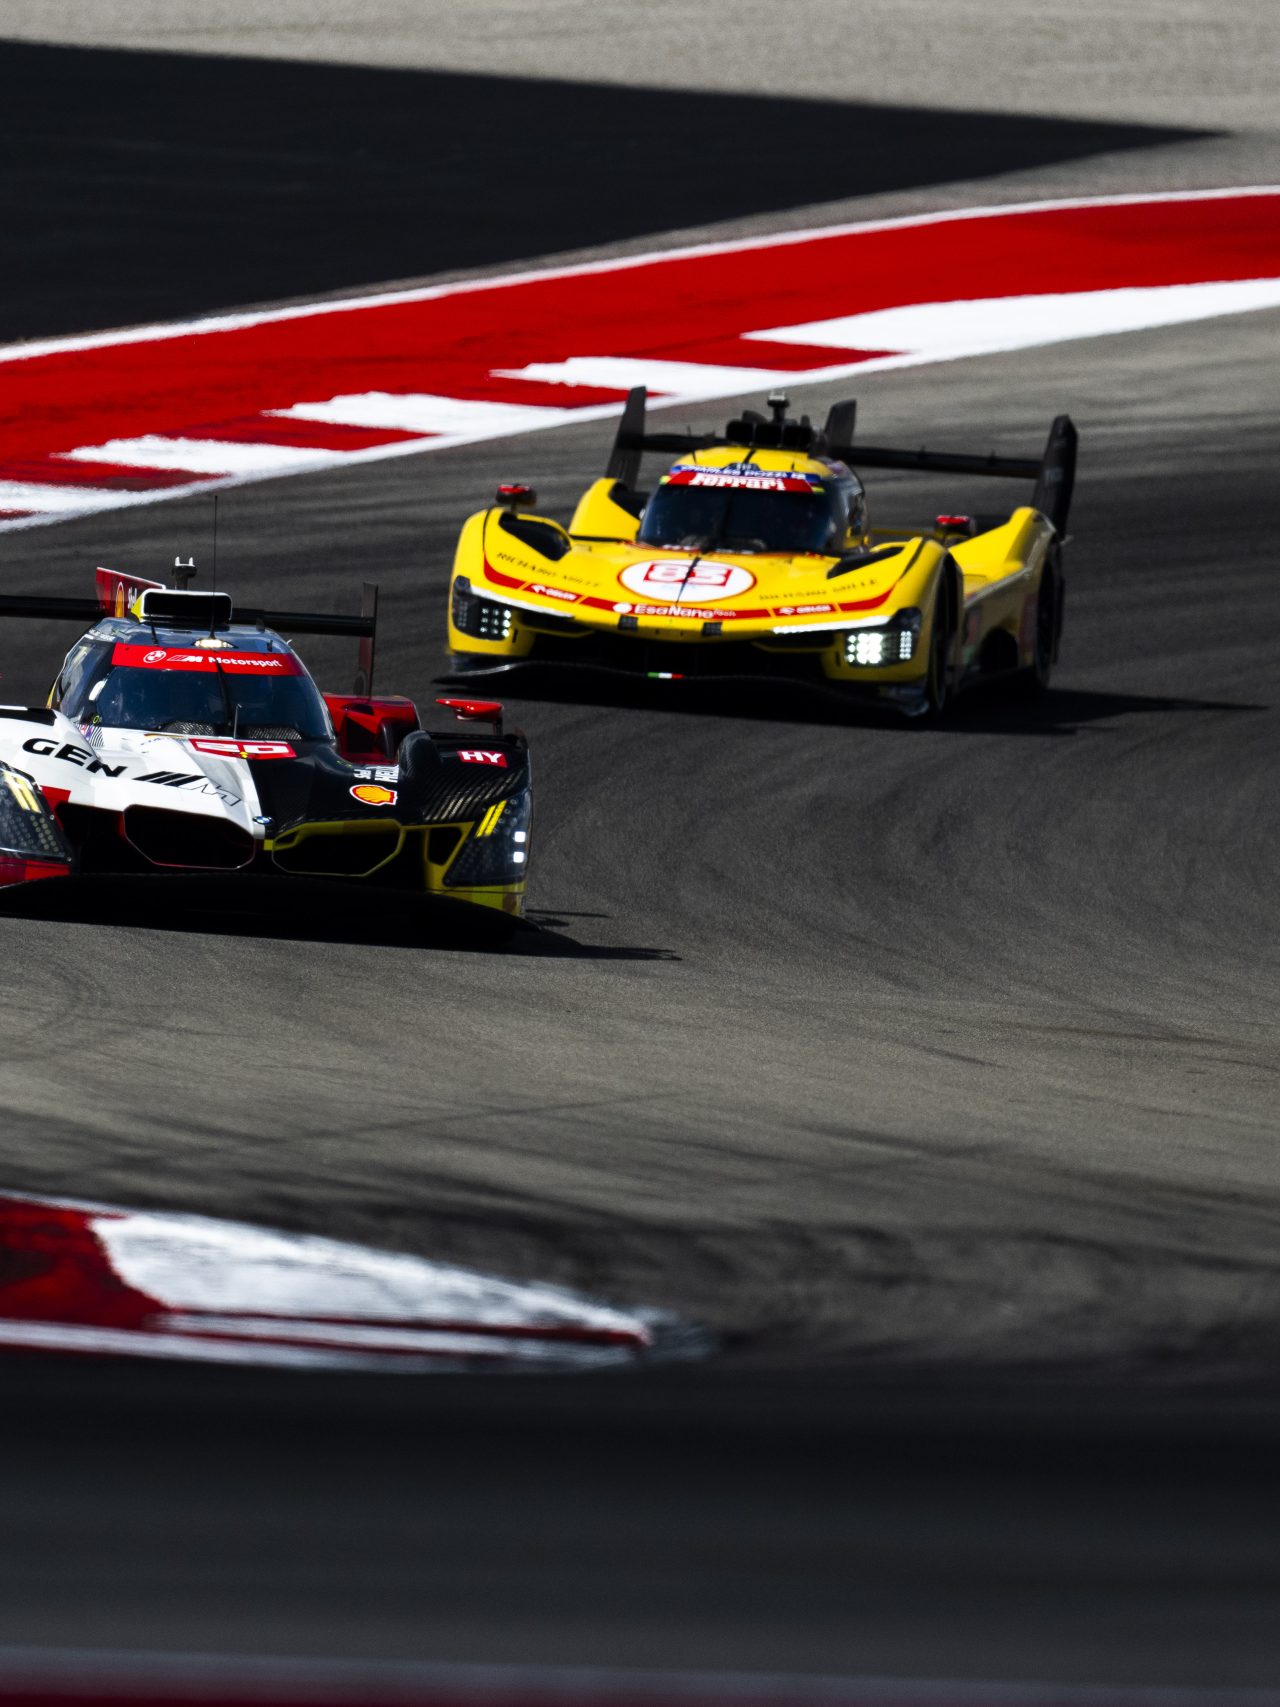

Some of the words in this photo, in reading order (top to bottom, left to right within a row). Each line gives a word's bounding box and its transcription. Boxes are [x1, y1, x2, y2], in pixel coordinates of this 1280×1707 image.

[688, 472, 786, 490] Ferrari
[647, 564, 730, 587] 83
[208, 656, 283, 668] Motorsport
[195, 741, 290, 754] 20
[22, 738, 128, 778] GEN
[461, 751, 503, 764] HY
